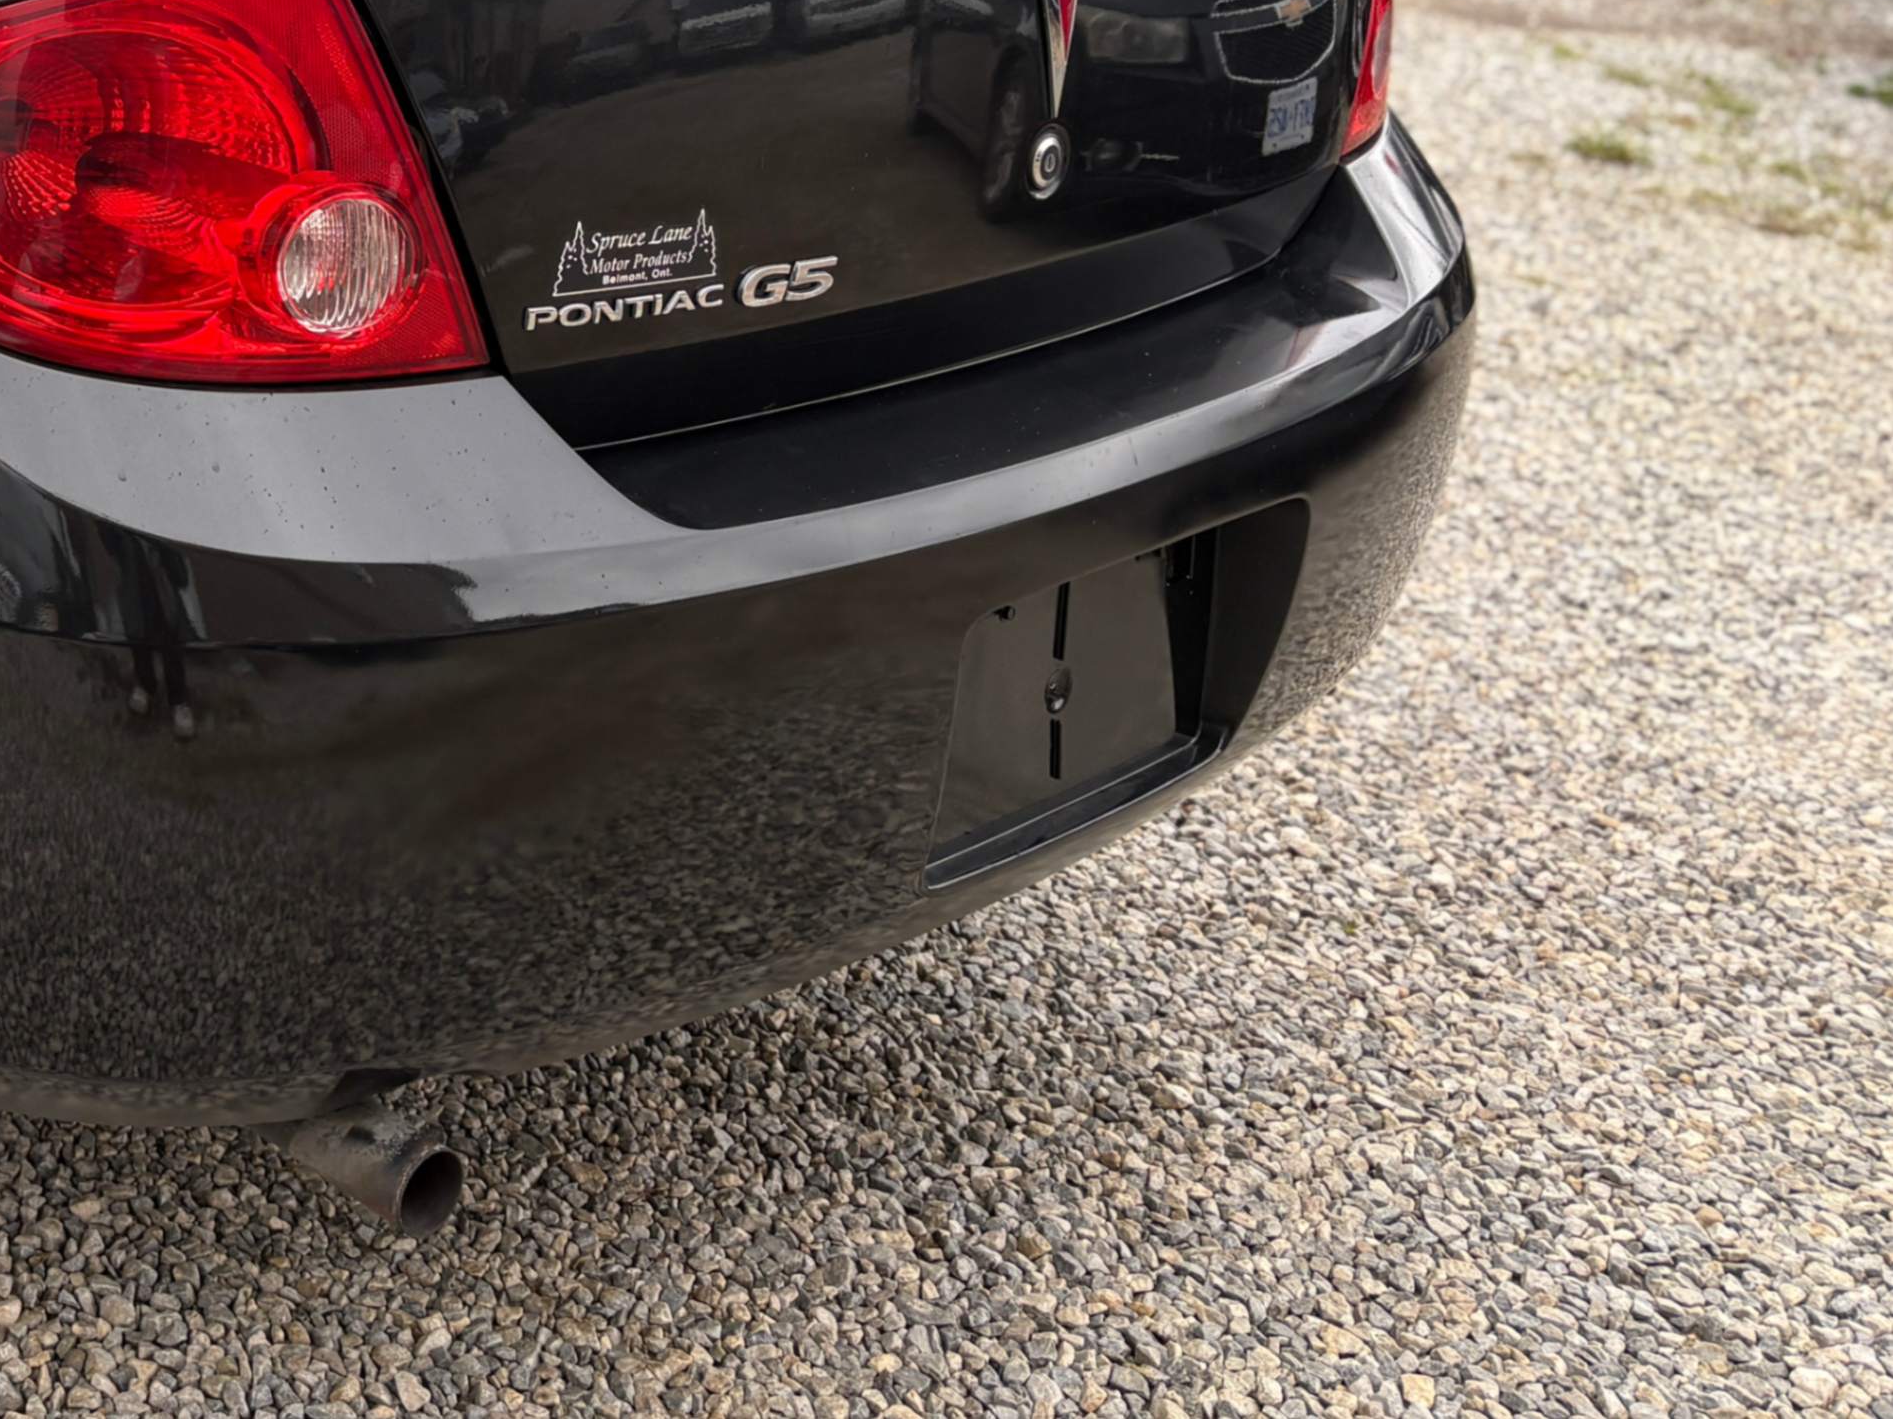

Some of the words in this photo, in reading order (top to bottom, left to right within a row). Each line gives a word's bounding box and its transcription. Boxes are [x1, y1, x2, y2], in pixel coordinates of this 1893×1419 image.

[586, 232, 646, 257] Spruce
[648, 225, 693, 245] Lane
[590, 257, 631, 274] Motor
[527, 284, 725, 331] PONTIAC
[740, 256, 838, 308] G5
